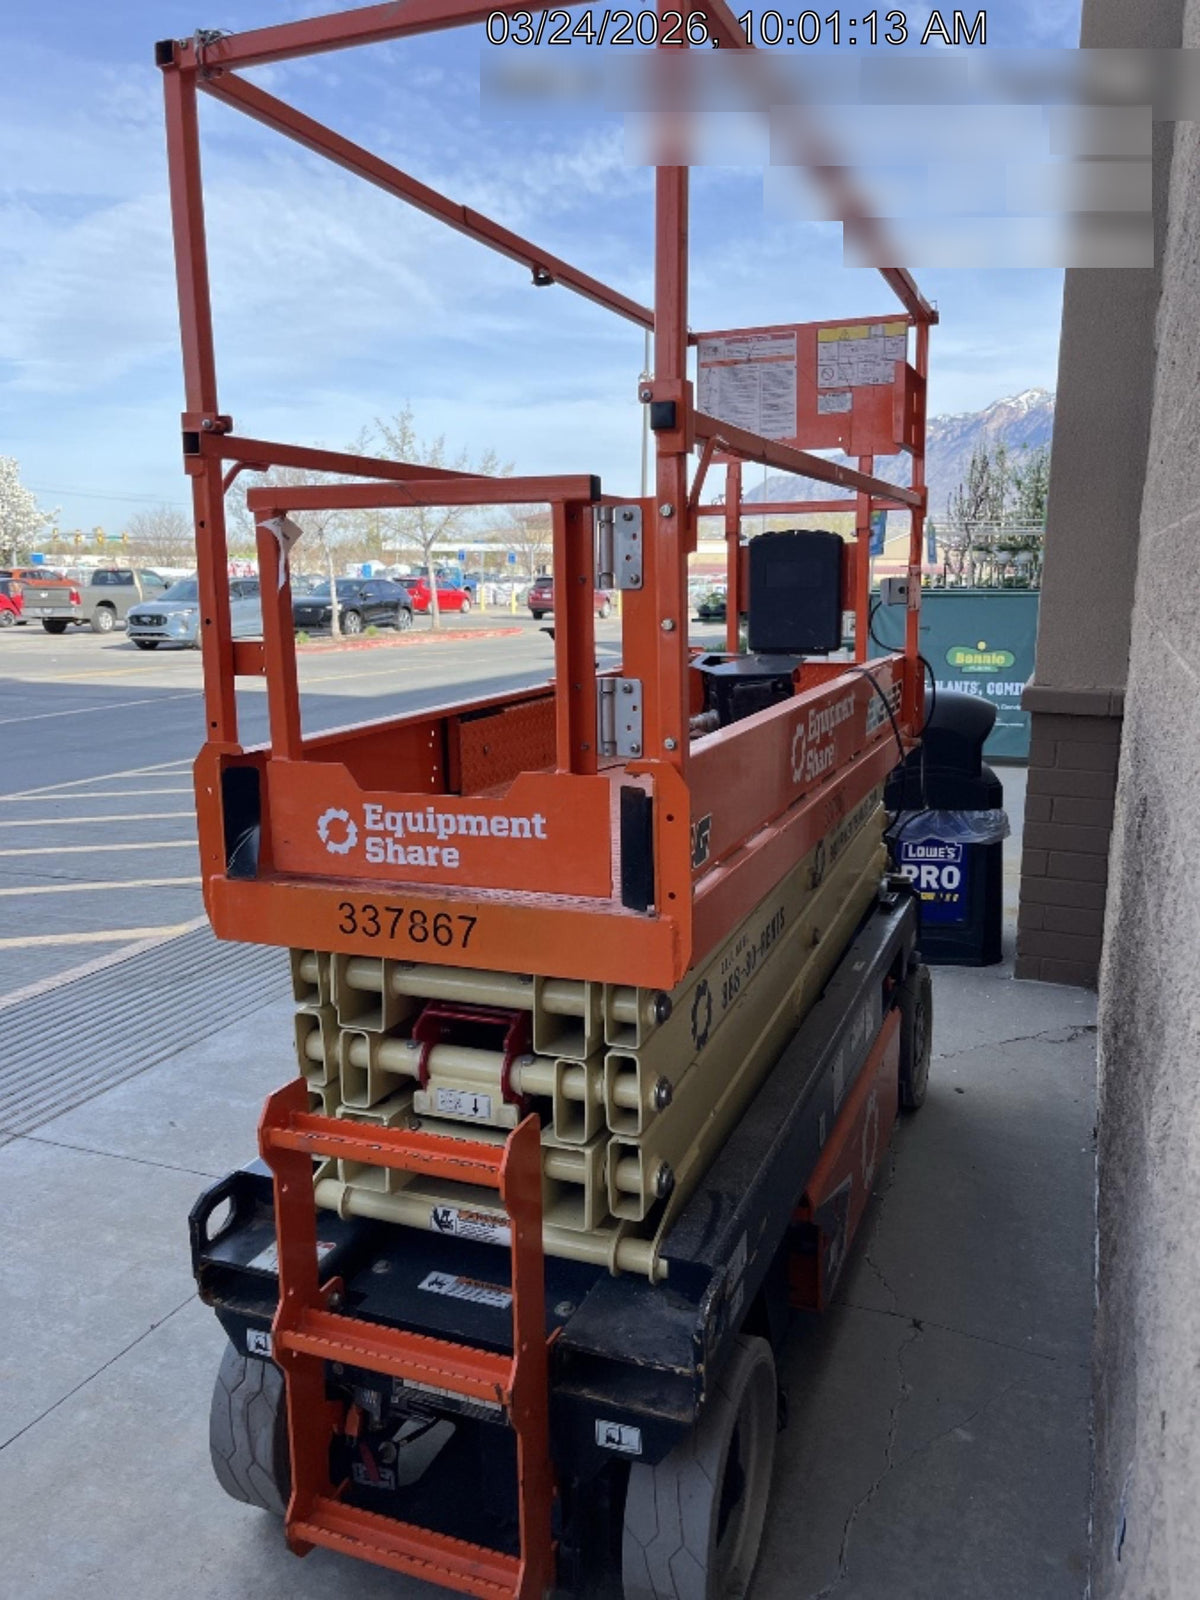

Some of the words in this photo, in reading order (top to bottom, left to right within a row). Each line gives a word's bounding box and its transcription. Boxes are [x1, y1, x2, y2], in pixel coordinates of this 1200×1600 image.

[955, 652, 1006, 665] Bonnie
[807, 691, 856, 744] Equipment
[805, 744, 834, 783] Share
[362, 803, 547, 839] Equipment
[364, 836, 461, 869] Share
[908, 844, 957, 859] LOWE'S
[901, 863, 961, 890] PRO
[338, 902, 478, 949] 337867
